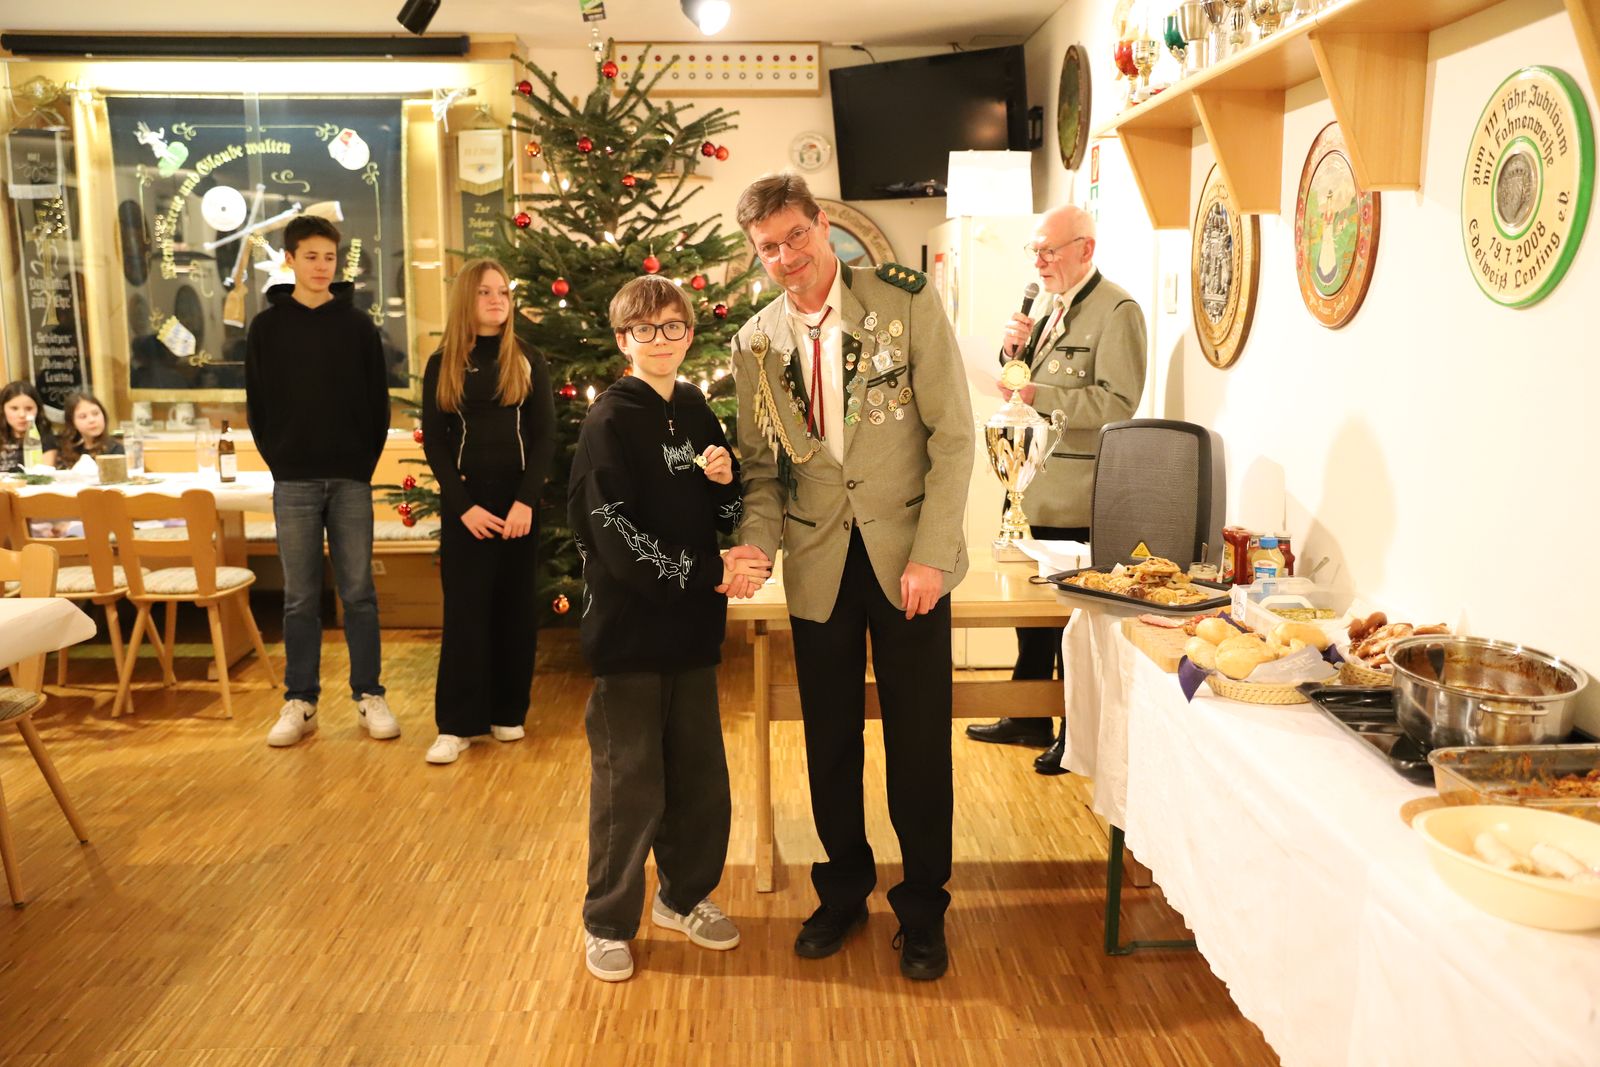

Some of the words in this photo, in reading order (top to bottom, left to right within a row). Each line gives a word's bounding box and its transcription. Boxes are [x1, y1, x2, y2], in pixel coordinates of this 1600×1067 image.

[179, 171, 201, 197] und
[195, 144, 244, 176] Glaube
[244, 138, 292, 155] walten
[1473, 146, 1486, 185] zum
[1484, 111, 1499, 139] 111
[1502, 88, 1528, 117] jähr.
[1528, 84, 1568, 156] Jubiläum
[1482, 151, 1496, 186] mit
[1494, 114, 1554, 168] Fahnenweihe
[1468, 218, 1508, 292] Edelweiß
[1514, 232, 1560, 289] Lenting
